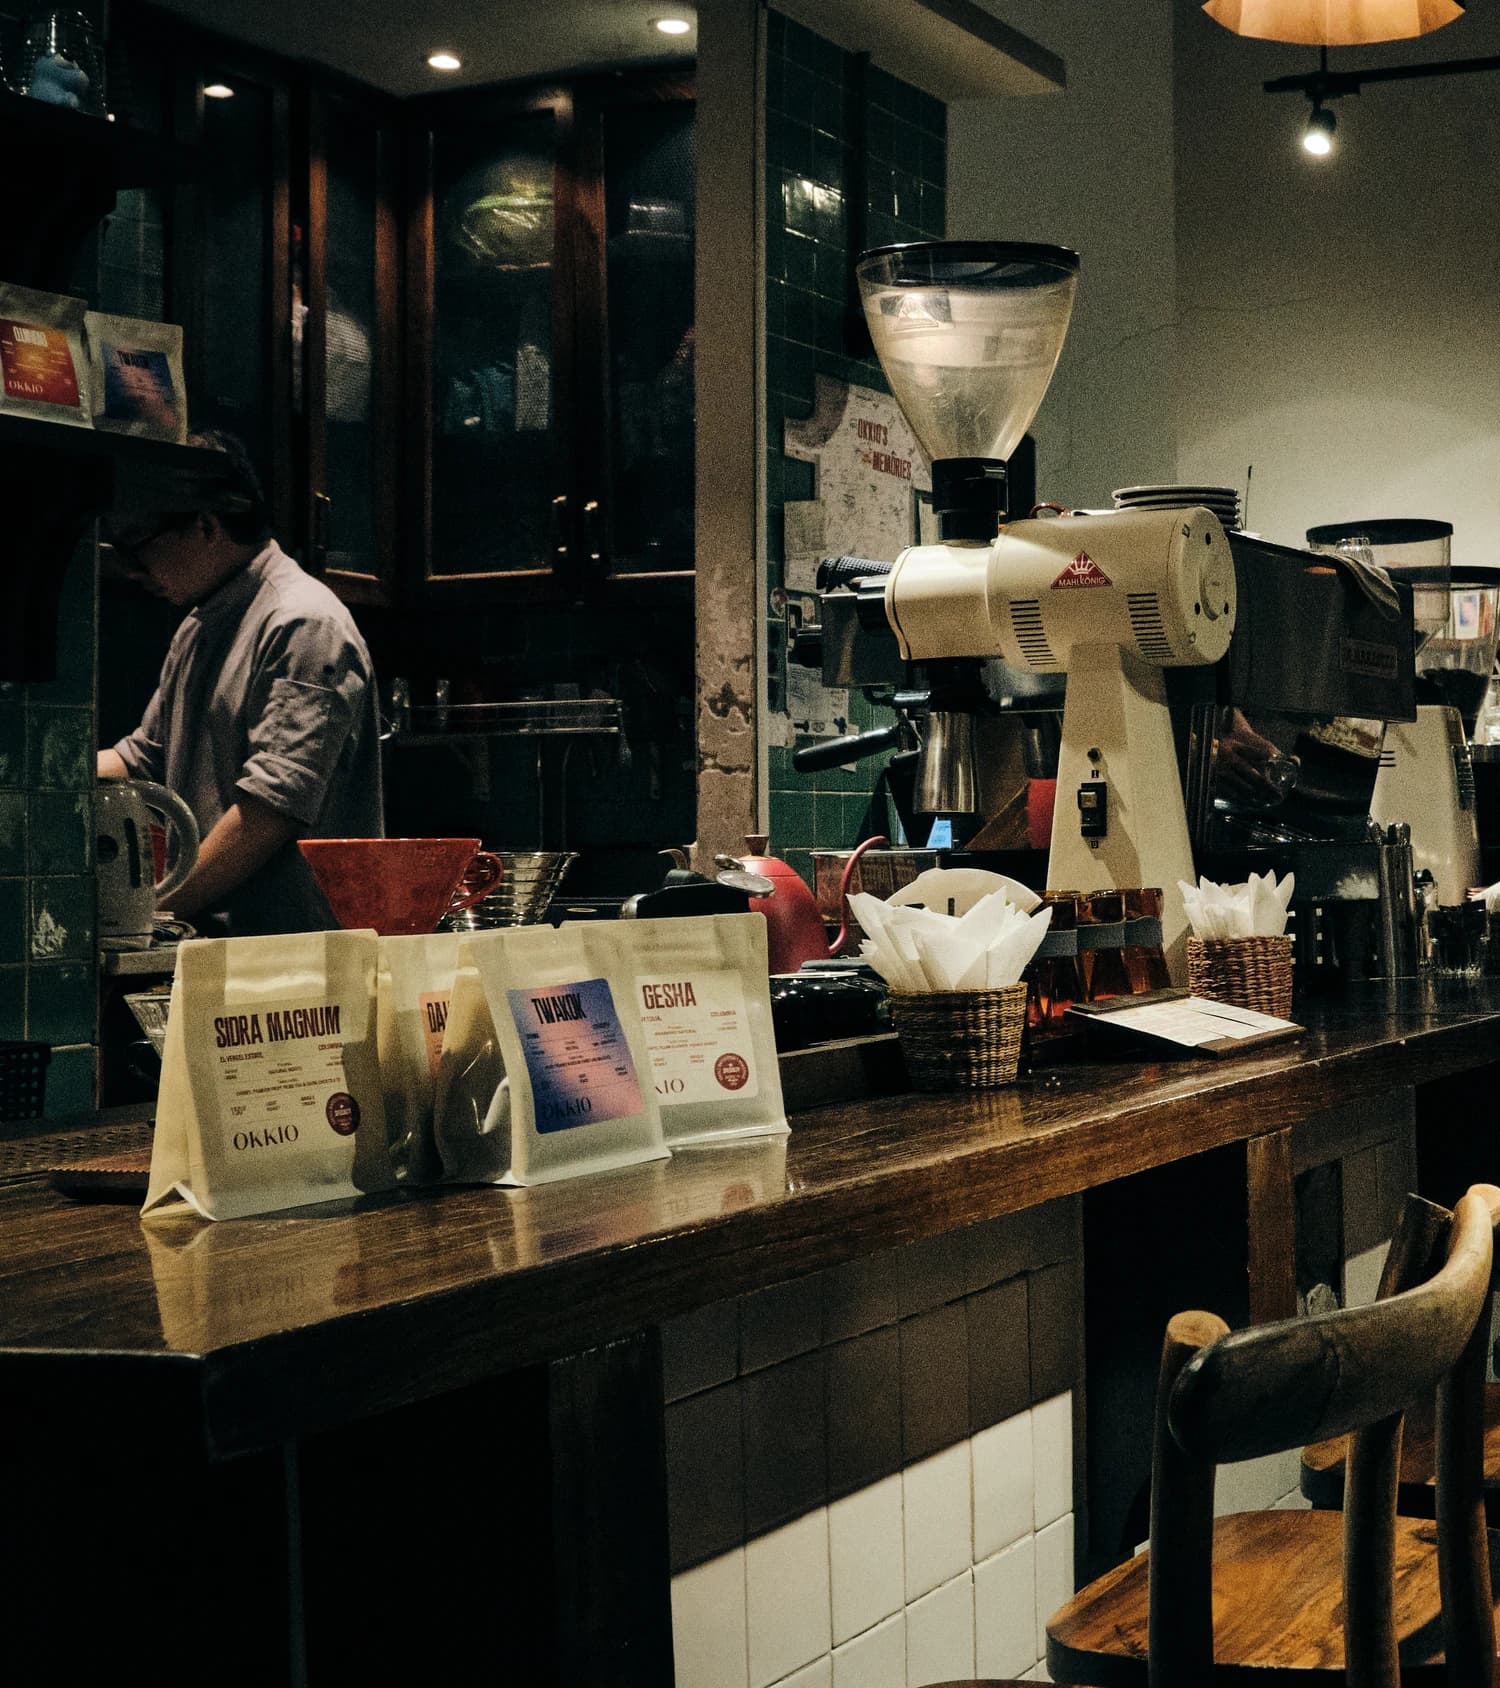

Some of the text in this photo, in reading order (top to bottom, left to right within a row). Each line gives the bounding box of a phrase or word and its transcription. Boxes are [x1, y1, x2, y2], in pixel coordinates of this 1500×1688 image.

[873, 450, 912, 480] MEMORIES
[642, 982, 697, 1010] GESHA
[214, 1005, 341, 1048] SIDRA MAGNUM
[233, 1124, 299, 1150] OKKIO
